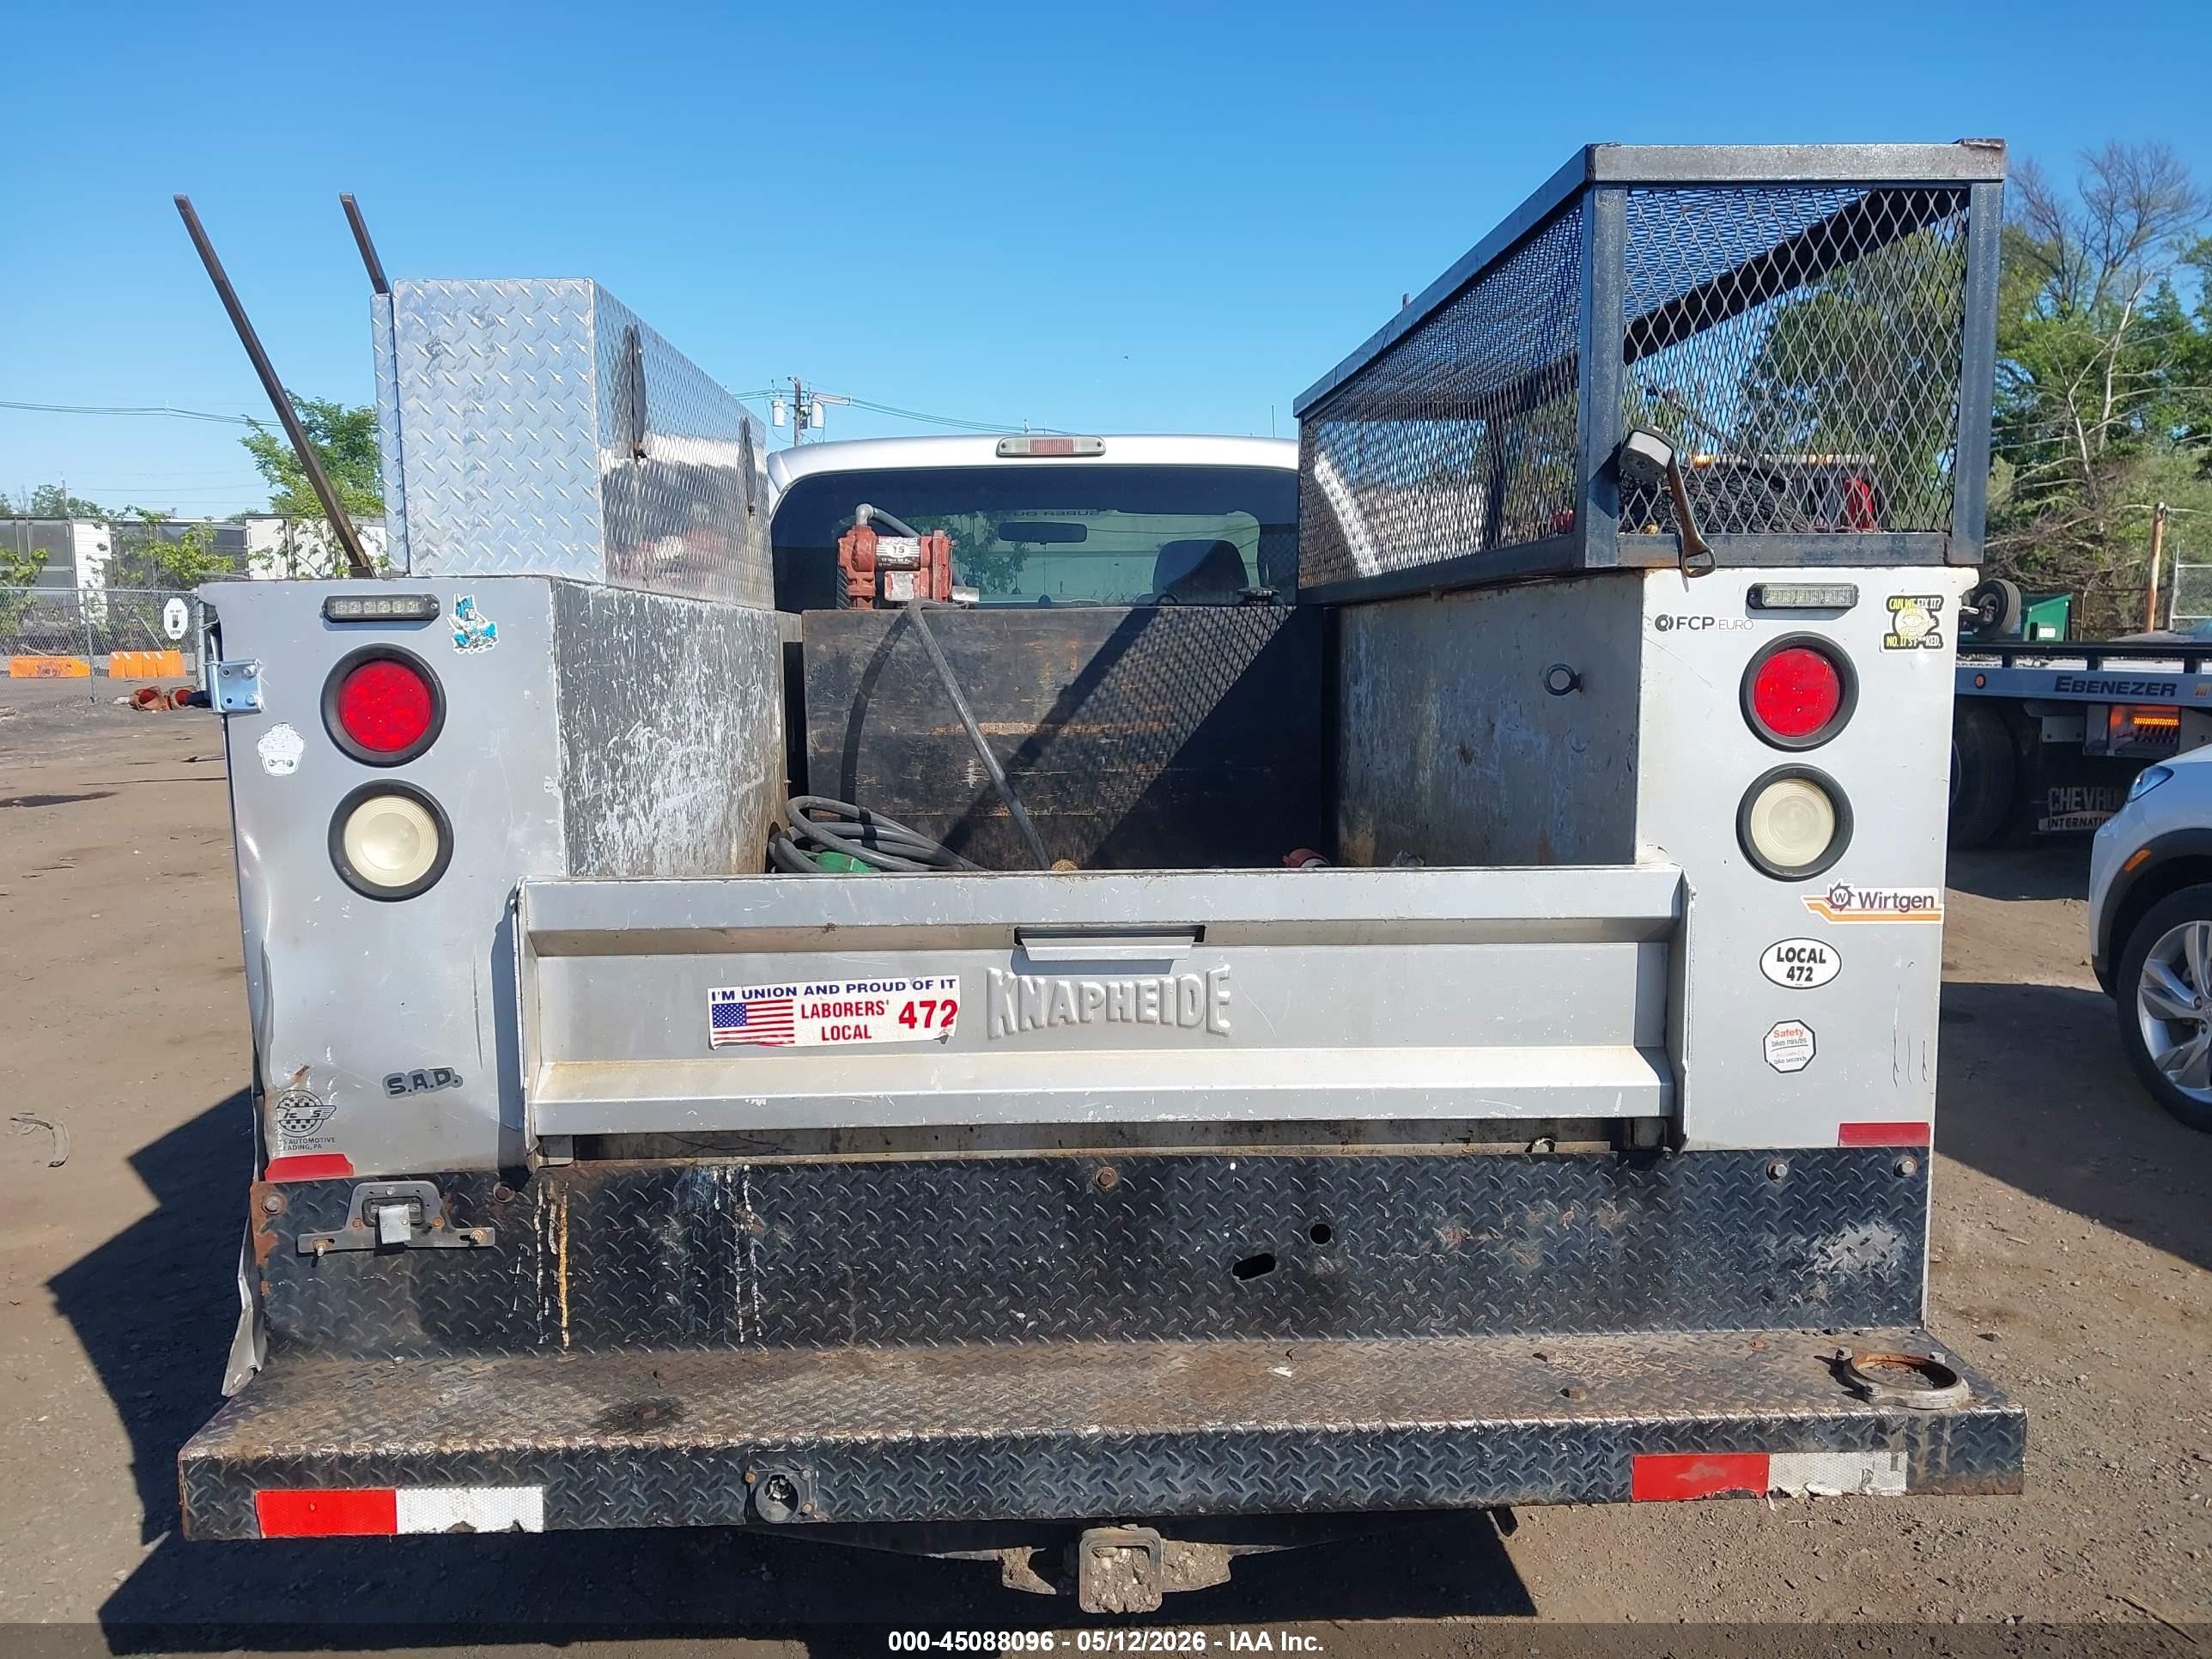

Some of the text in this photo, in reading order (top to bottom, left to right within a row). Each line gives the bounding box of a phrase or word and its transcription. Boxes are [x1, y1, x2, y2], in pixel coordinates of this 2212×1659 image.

[1889, 599, 1904, 610] CAN
[1905, 598, 1917, 609] WE
[1929, 597, 1942, 609] IT?
[1676, 616, 1754, 630] FCP EURO
[2055, 676, 2178, 697] EBENEZER
[1858, 891, 1935, 913] Wirtgen
[1777, 946, 1826, 963] LOCAL
[1786, 966, 1814, 981] 472
[712, 979, 957, 1001] I'M UNION AND PROUD OF IT
[988, 964, 1231, 1039] KNAPHEIDE
[801, 1000, 958, 1029] LABORERS' 472
[822, 1024, 872, 1041] LOCAL
[1773, 1028, 1804, 1037] Safety
[1771, 1039, 1786, 1048] takes
[387, 1070, 459, 1095] S.A.D.
[283, 1143, 313, 1152] EADING,
